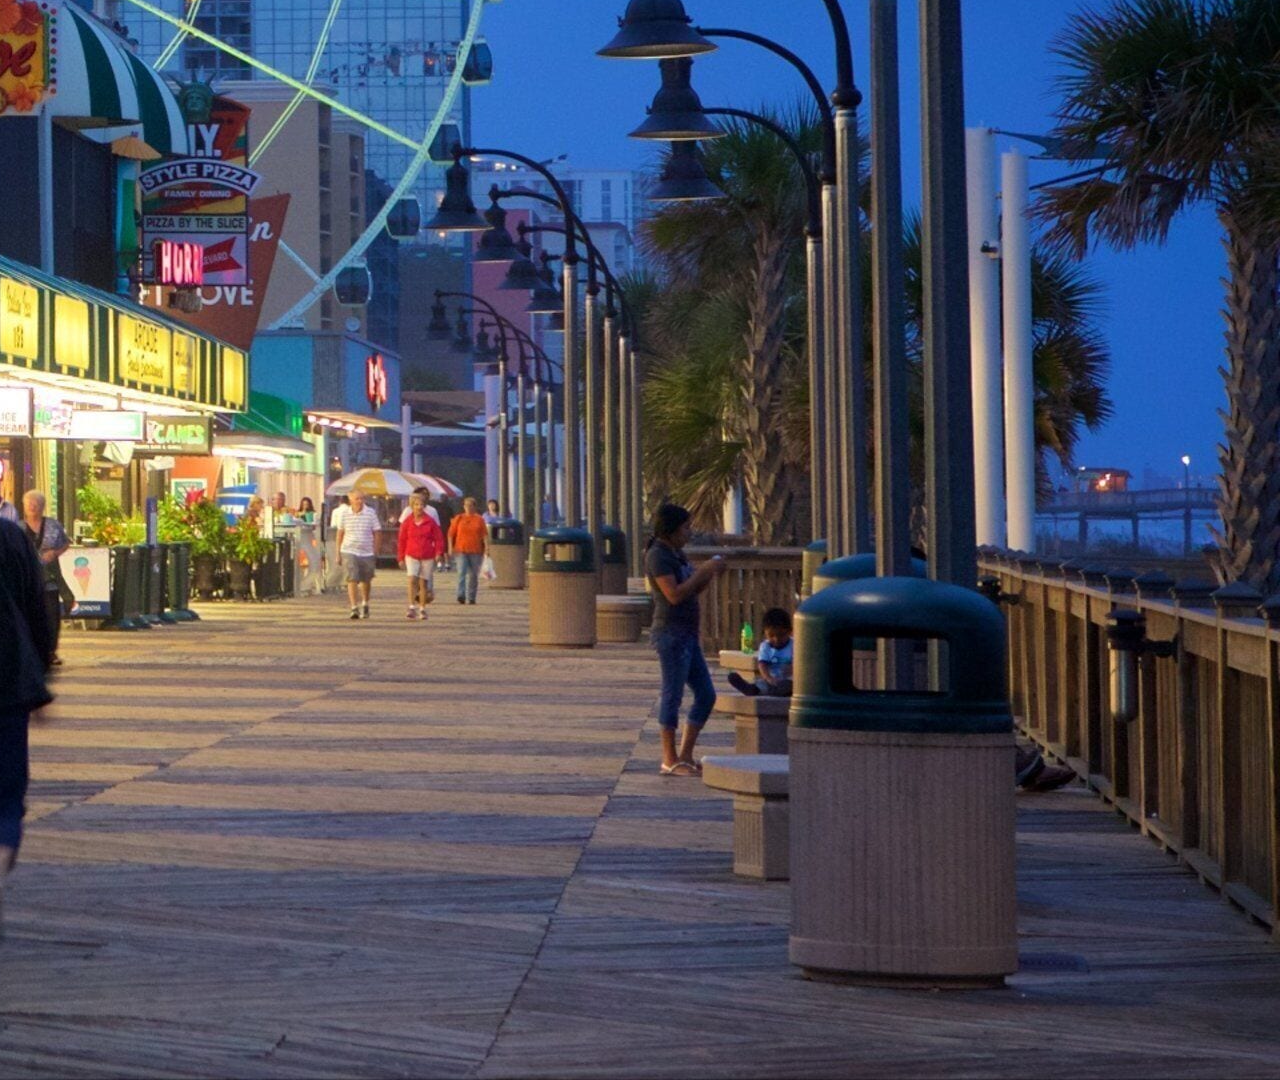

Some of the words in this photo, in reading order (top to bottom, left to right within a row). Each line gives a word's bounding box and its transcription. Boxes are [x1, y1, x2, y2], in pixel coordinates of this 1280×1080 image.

[142, 163, 198, 189] STYLE
[202, 163, 253, 190] PIZZA
[164, 190, 196, 198] FAMILY
[199, 190, 232, 198] DINING
[146, 217, 175, 229] PIZZA
[178, 217, 191, 229] BY
[195, 217, 214, 229] THE
[217, 217, 245, 229] SLICE
[1, 413, 16, 422] ICE
